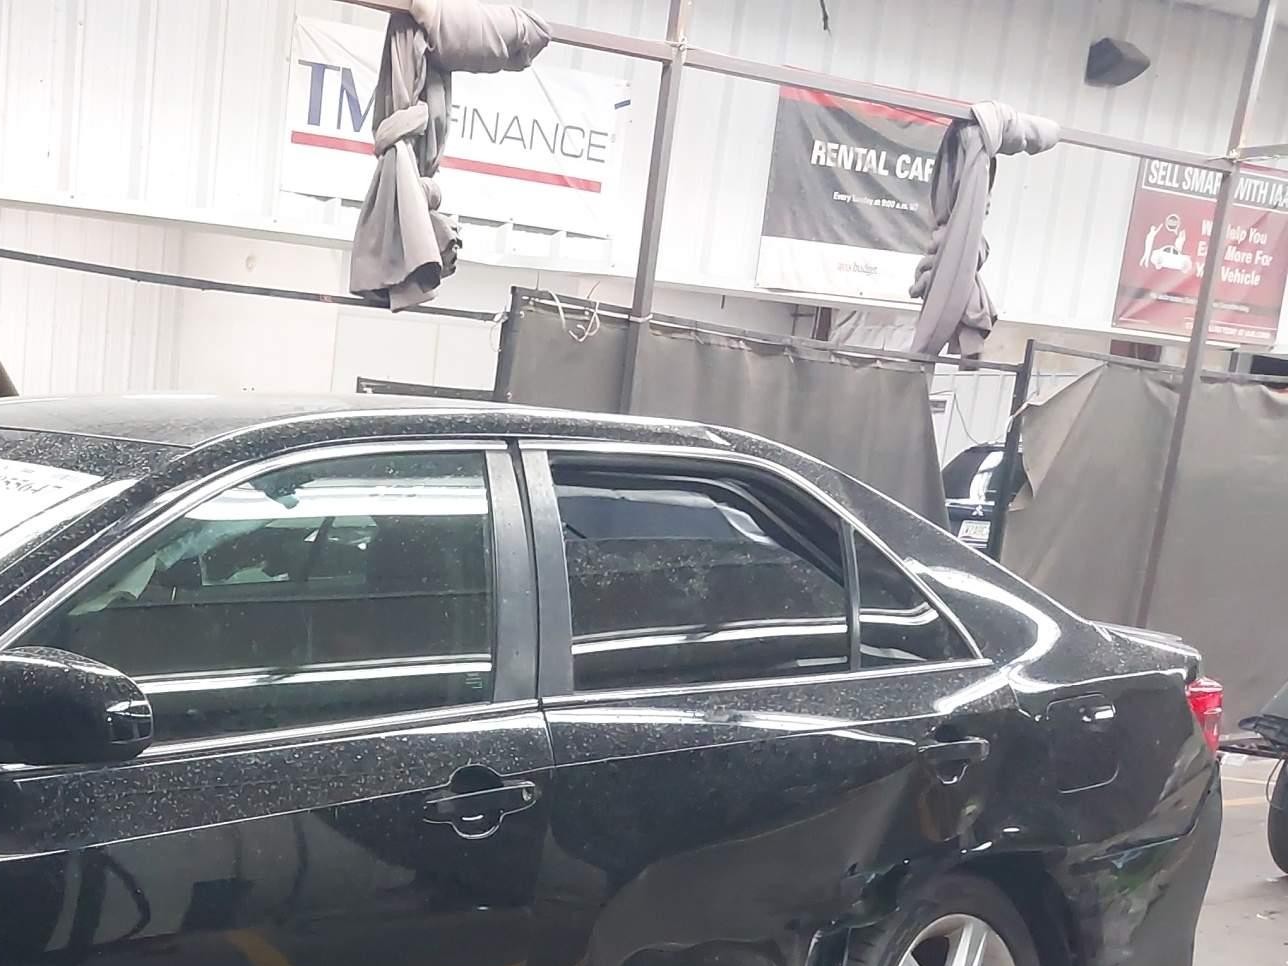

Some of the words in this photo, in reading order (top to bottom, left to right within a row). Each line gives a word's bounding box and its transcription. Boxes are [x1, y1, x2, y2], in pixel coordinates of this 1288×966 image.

[298, 59, 376, 132] TM
[811, 139, 889, 176] RENTAL
[1148, 160, 1179, 187] SELL
[1182, 166, 1222, 195] SMAR
[1248, 227, 1267, 244] You
[1224, 245, 1253, 264] More
[1255, 251, 1273, 266] For
[1221, 266, 1261, 286] Vehicle
